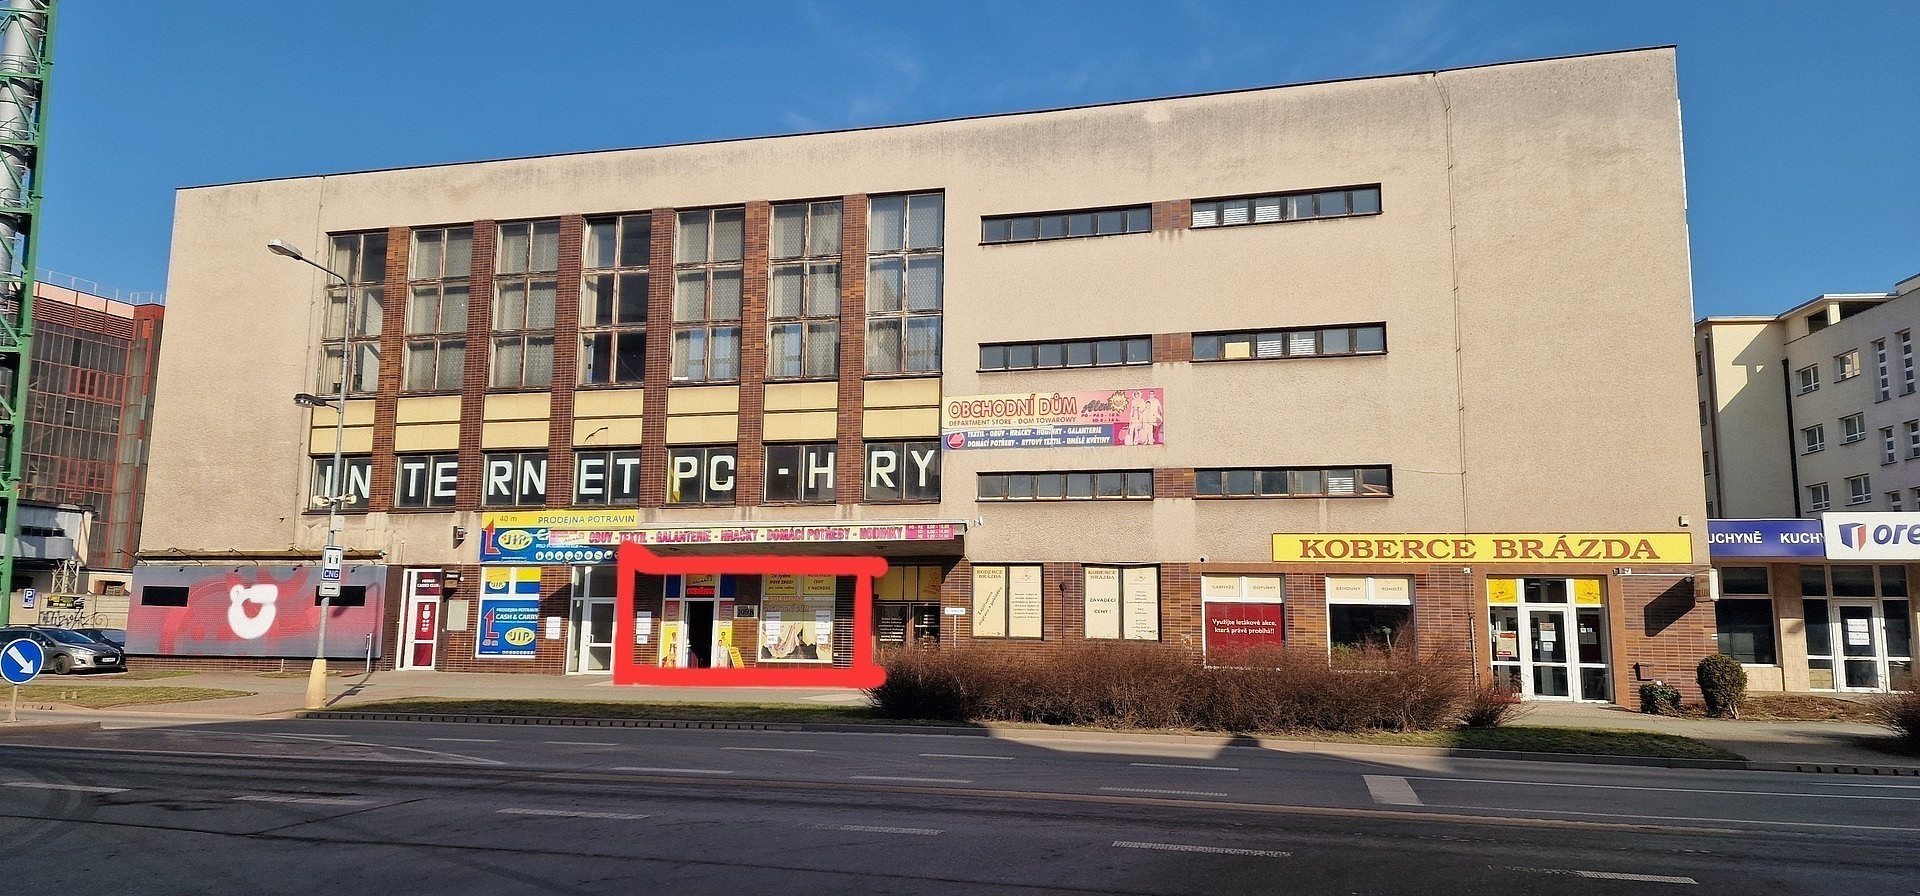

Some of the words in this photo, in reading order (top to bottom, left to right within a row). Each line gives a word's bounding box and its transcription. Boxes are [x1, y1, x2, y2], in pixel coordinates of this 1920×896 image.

[949, 394, 1036, 418] OBCHODNÍ
[1039, 393, 1078, 416] DŮM
[1067, 426, 1102, 434] GALANTERIE
[967, 439, 989, 447] DOMÁCÍ
[990, 439, 1016, 447] POTŘEBY
[1021, 437, 1042, 446] BYTOVÝ
[1043, 437, 1062, 445] TEXTIL
[673, 455, 735, 492] PC
[808, 450, 936, 488] HRY
[537, 516, 585, 525] PRODEJNA
[587, 515, 635, 523] POTRAVIN
[588, 532, 613, 544] OBUV
[619, 530, 647, 544] TEXTIL
[656, 529, 712, 543] GALANTERIE
[721, 527, 759, 541] HRAČKY
[766, 526, 804, 541] DOMÁCÍ
[807, 526, 850, 540] POTŘEBY
[859, 526, 903, 539] HODINKY
[1299, 539, 1476, 560] KOBERCE
[1493, 535, 1660, 560] BRÁZDA
[324, 570, 339, 578] CNG
[26, 589, 33, 599] P
[1212, 618, 1236, 627] Využijte
[509, 631, 531, 641] JIP
